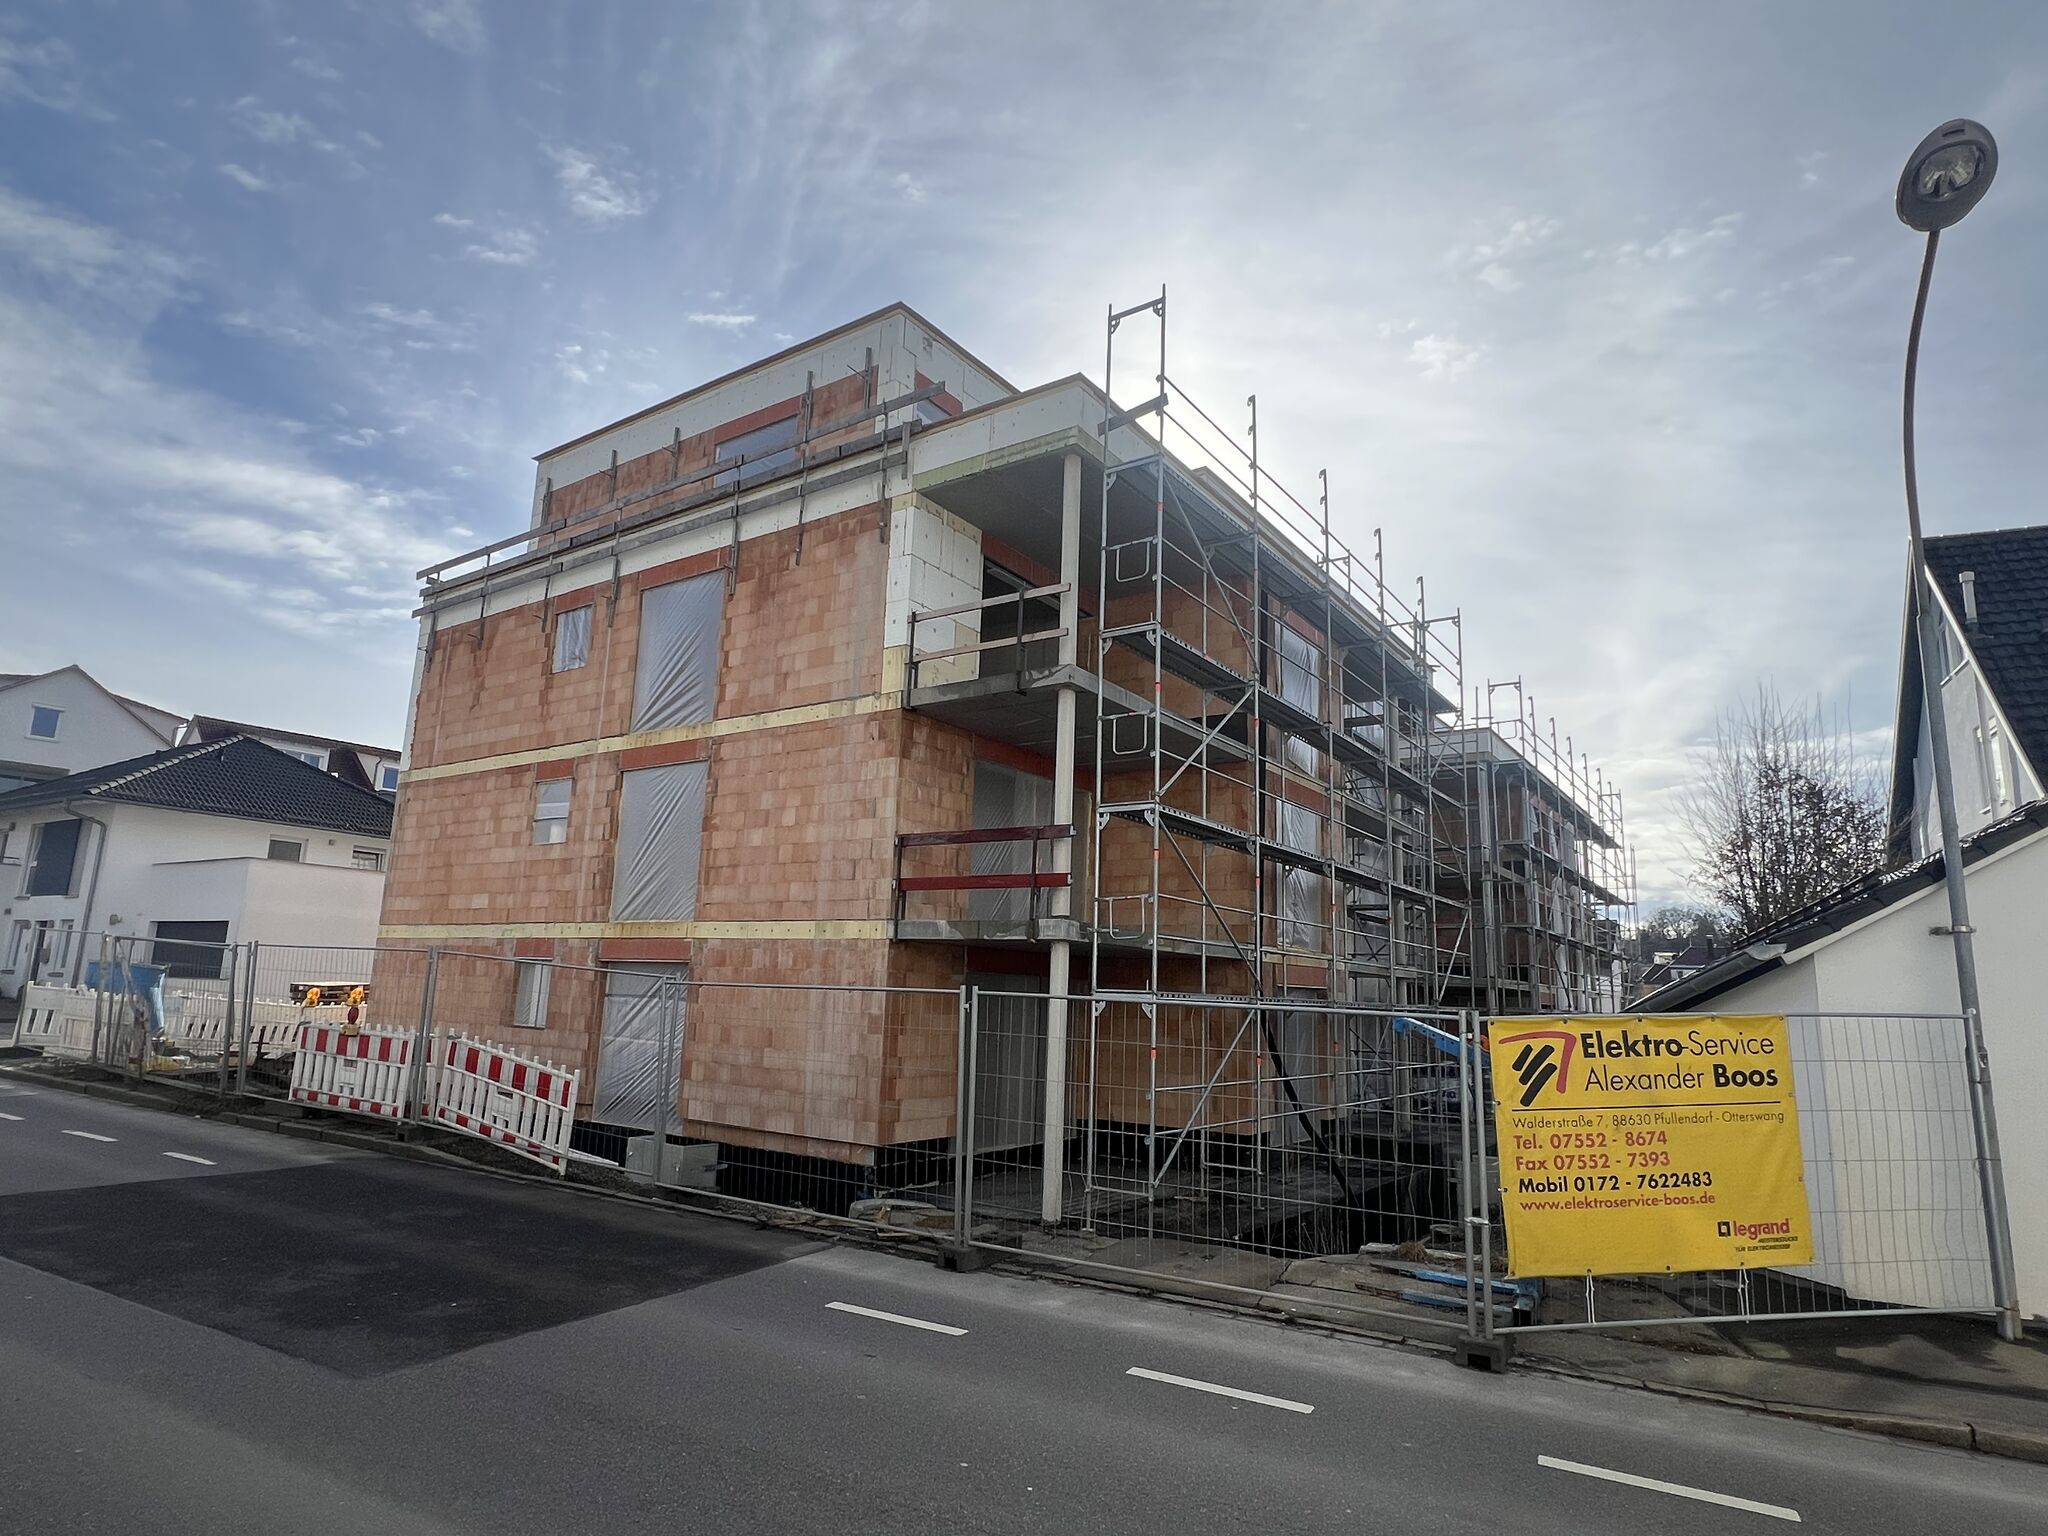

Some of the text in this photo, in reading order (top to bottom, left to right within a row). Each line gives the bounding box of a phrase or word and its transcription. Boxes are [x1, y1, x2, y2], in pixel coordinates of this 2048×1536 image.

[1580, 1030, 1775, 1058] Elektro-Service
[1584, 1063, 1779, 1092] Alexander Boos
[1512, 1115, 1594, 1129] Walderstraße
[1612, 1113, 1652, 1127] 88630
[1654, 1110, 1713, 1125] Pfullendorf
[1721, 1110, 1785, 1124] Otterswang
[1513, 1133, 1543, 1149] Tel.
[1550, 1132, 1607, 1149] 07552
[1625, 1130, 1668, 1147] 8674
[1515, 1156, 1549, 1171] Fax
[1553, 1153, 1611, 1170] 07552
[1627, 1151, 1671, 1168] 7393
[1519, 1175, 1568, 1193] Mobil
[1574, 1175, 1620, 1192] 0172
[1637, 1171, 1713, 1190] 7622483
[1520, 1191, 1716, 1211] www.elektroservice-boos.de
[1733, 1218, 1790, 1240] legrand
